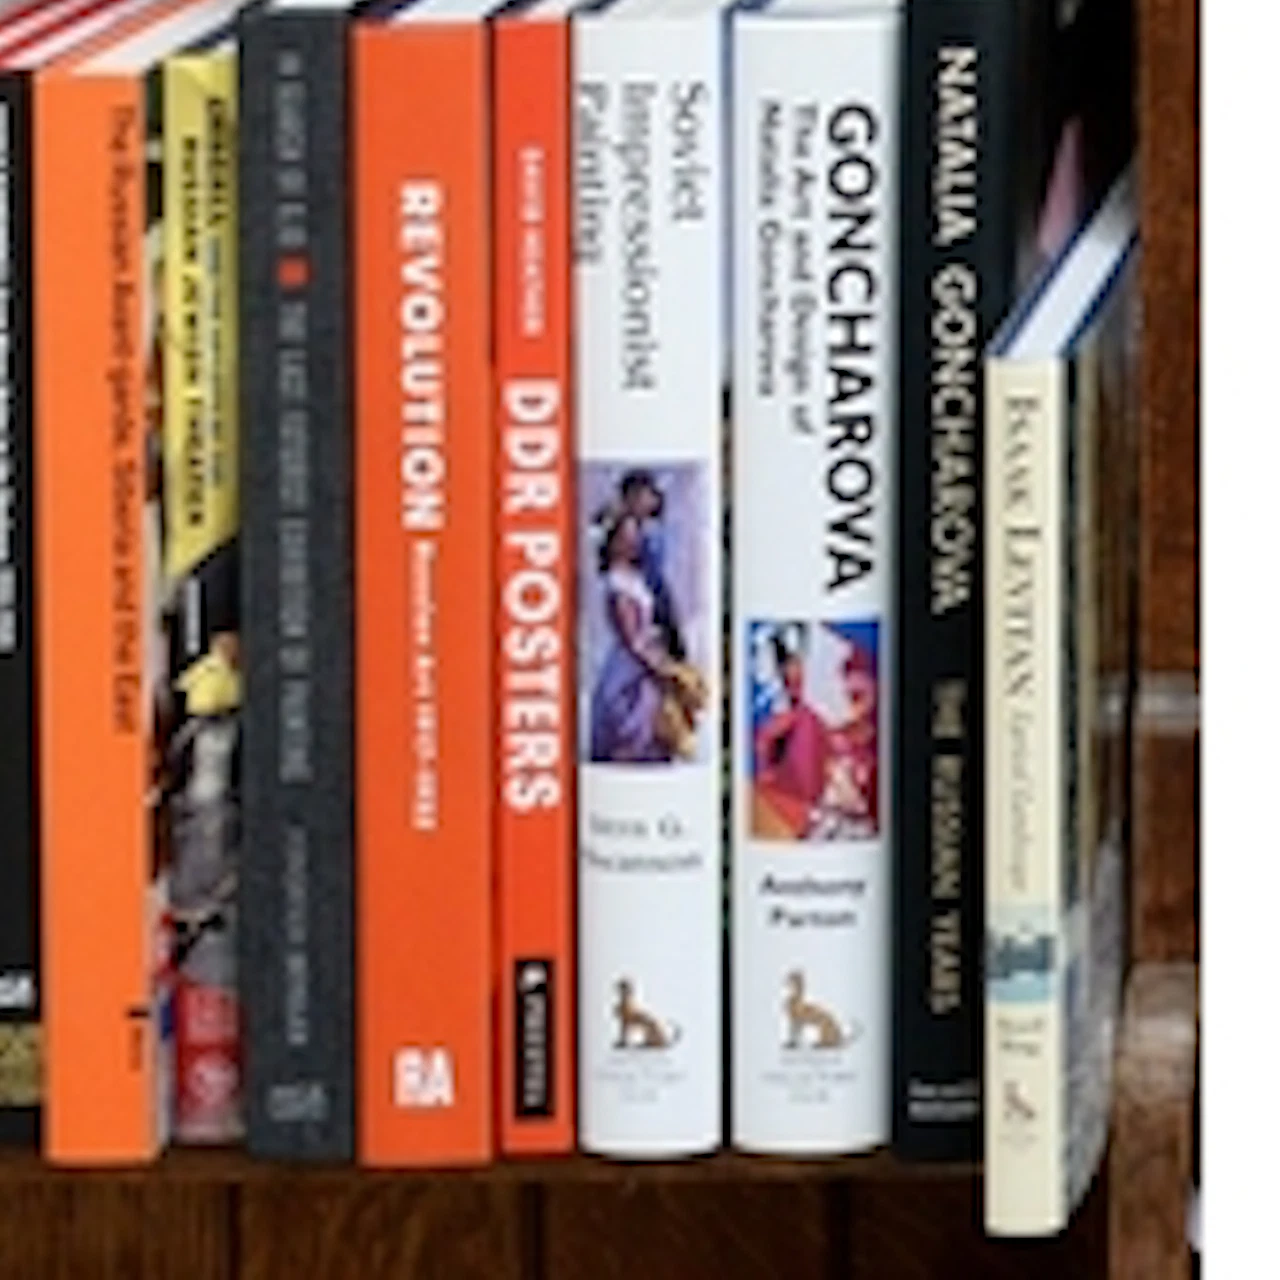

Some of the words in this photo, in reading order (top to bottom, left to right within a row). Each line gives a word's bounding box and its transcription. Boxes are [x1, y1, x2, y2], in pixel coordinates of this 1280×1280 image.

[671, 81, 710, 222] Soviet
[790, 105, 818, 159] The
[791, 166, 819, 219] Art
[932, 46, 976, 242] NATALIA
[615, 82, 659, 391] Impressionist
[791, 230, 816, 282] and
[401, 181, 445, 531] REVOLUTION
[758, 219, 783, 397] Goncharova
[786, 294, 818, 396] Design
[826, 104, 877, 593] GONCHAROVA
[502, 379, 562, 515] DDR
[792, 405, 817, 435] of
[931, 265, 976, 613] GONCHAROVA
[501, 530, 562, 811] POSTERS
[930, 678, 963, 739] THE
[929, 754, 963, 900] RUSSIAN
[928, 909, 963, 1016] YEARS
